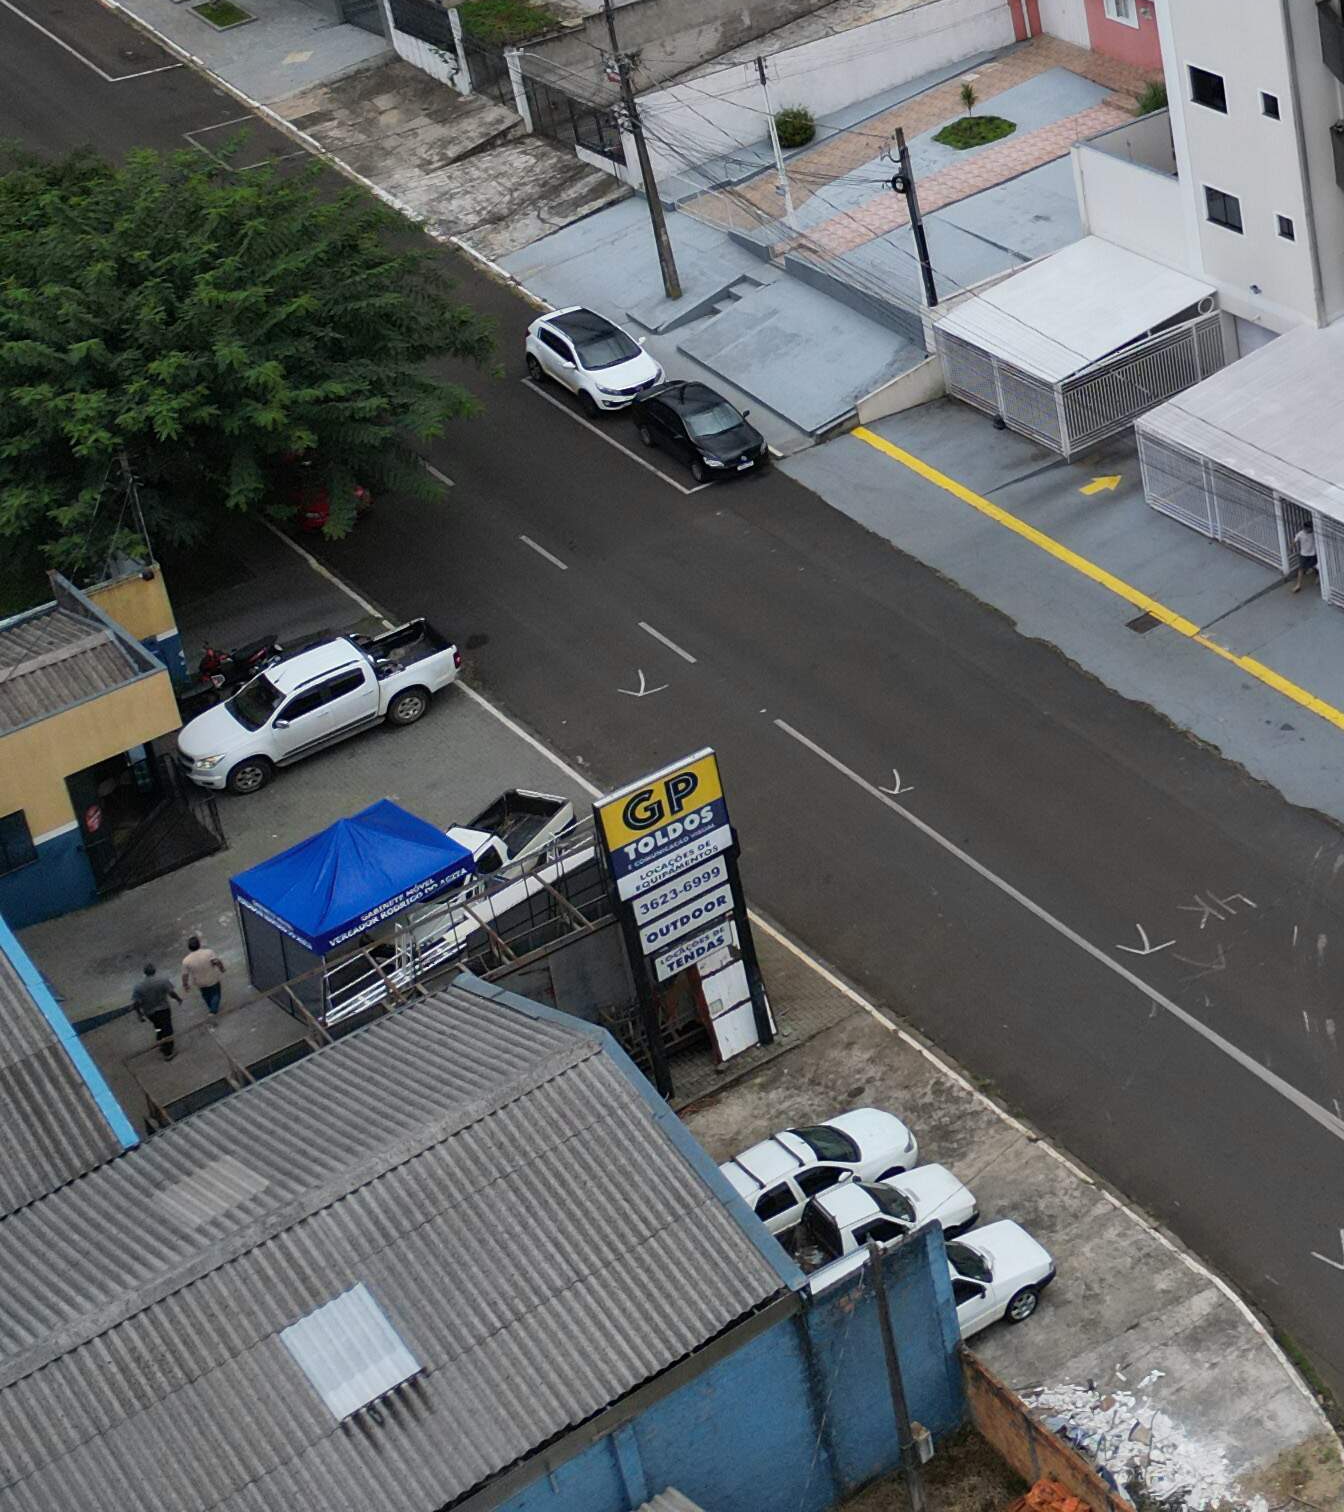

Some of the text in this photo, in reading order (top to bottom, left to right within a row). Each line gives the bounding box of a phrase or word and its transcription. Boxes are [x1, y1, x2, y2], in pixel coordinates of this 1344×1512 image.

[622, 771, 699, 831] GP
[624, 805, 714, 861] TOLDOS
[697, 839, 712, 851] DE
[635, 844, 719, 892] EQUIPAMENTOS
[639, 866, 721, 916] 3623-6999
[328, 915, 380, 947] VEREADOR
[380, 891, 424, 920] RODRIGO
[646, 894, 728, 944] OUTDOOR
[667, 935, 725, 972] TENDAS
